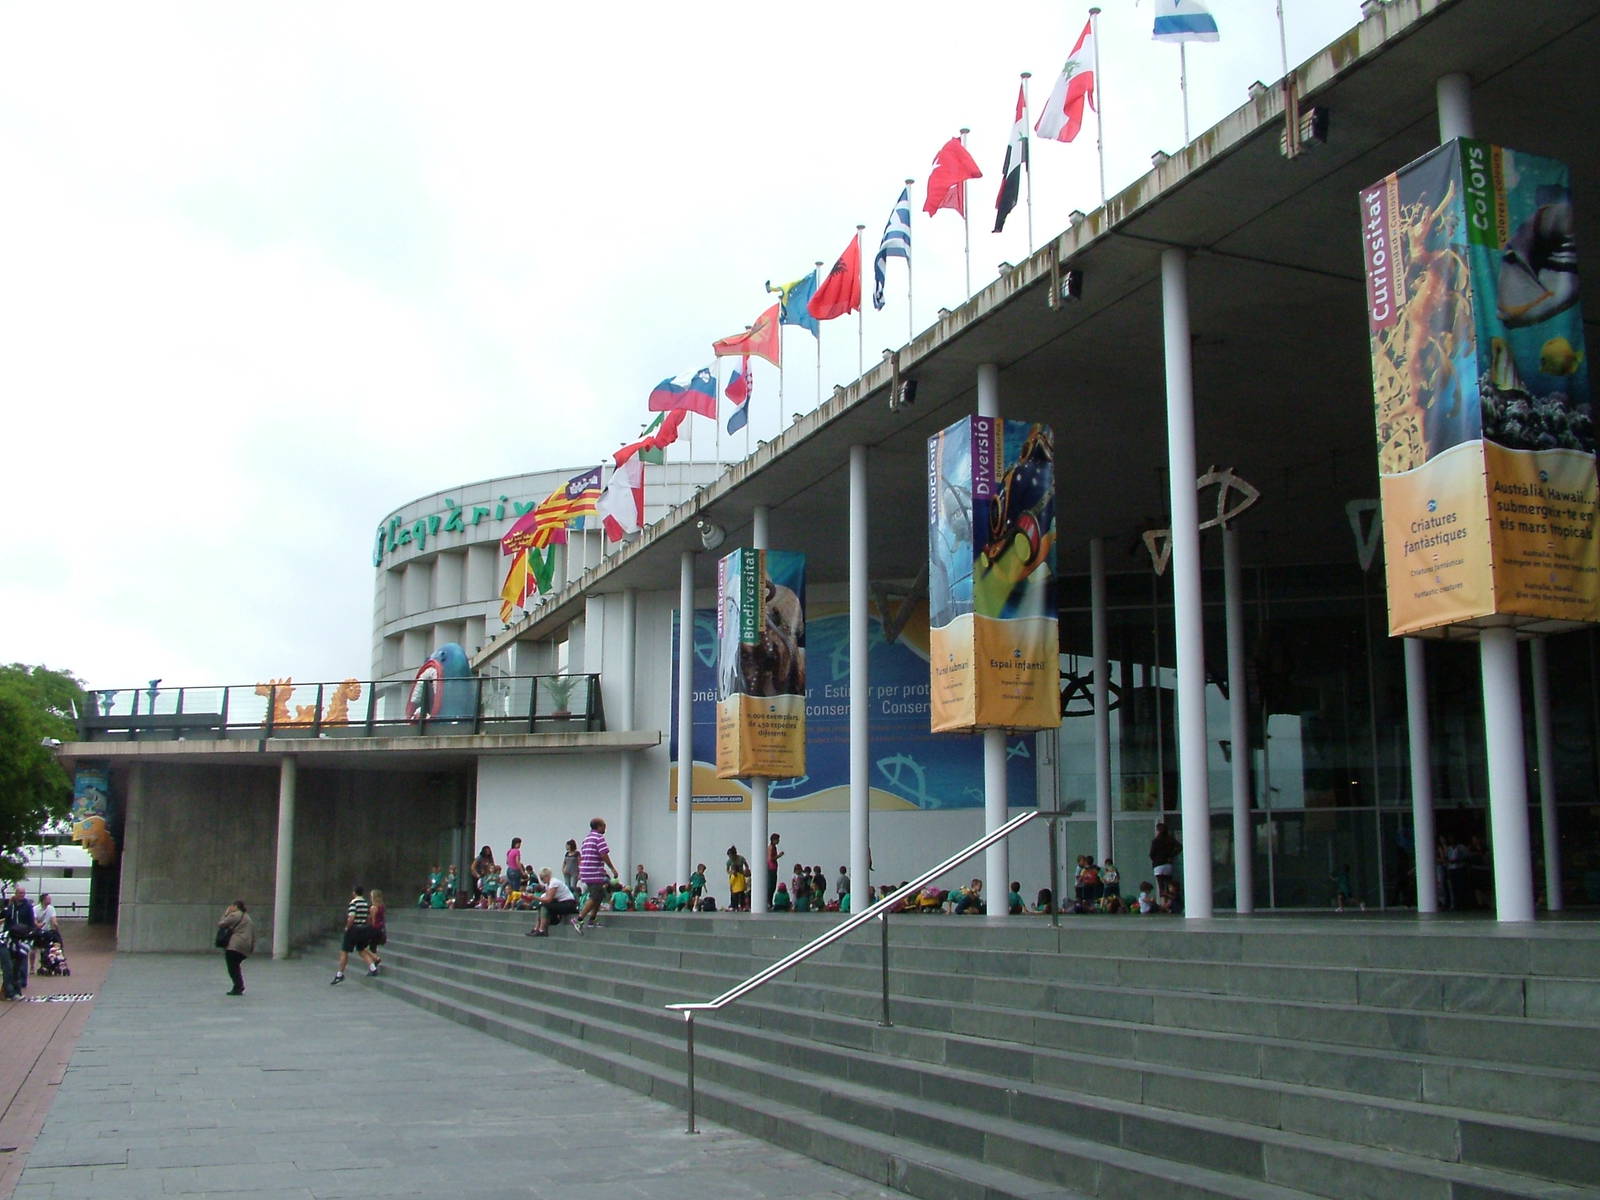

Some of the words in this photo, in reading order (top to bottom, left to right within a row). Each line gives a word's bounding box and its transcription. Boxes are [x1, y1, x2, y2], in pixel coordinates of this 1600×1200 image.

[1468, 147, 1488, 230] Colors
[1366, 189, 1389, 321] Curiositat
[974, 421, 989, 495] Diversió
[1411, 512, 1457, 534] Criatures
[1580, 511, 1594, 521] en
[1500, 517, 1515, 531] els
[1519, 522, 1547, 534] mars
[1549, 522, 1593, 540] tropicals
[1403, 528, 1467, 557] fantàstiques
[743, 551, 755, 639] Biodiversitat
[990, 659, 1012, 670] Espai
[1015, 660, 1046, 671] infantil
[877, 686, 899, 700] per
[903, 684, 931, 699] prot
[882, 700, 931, 714] Conser
